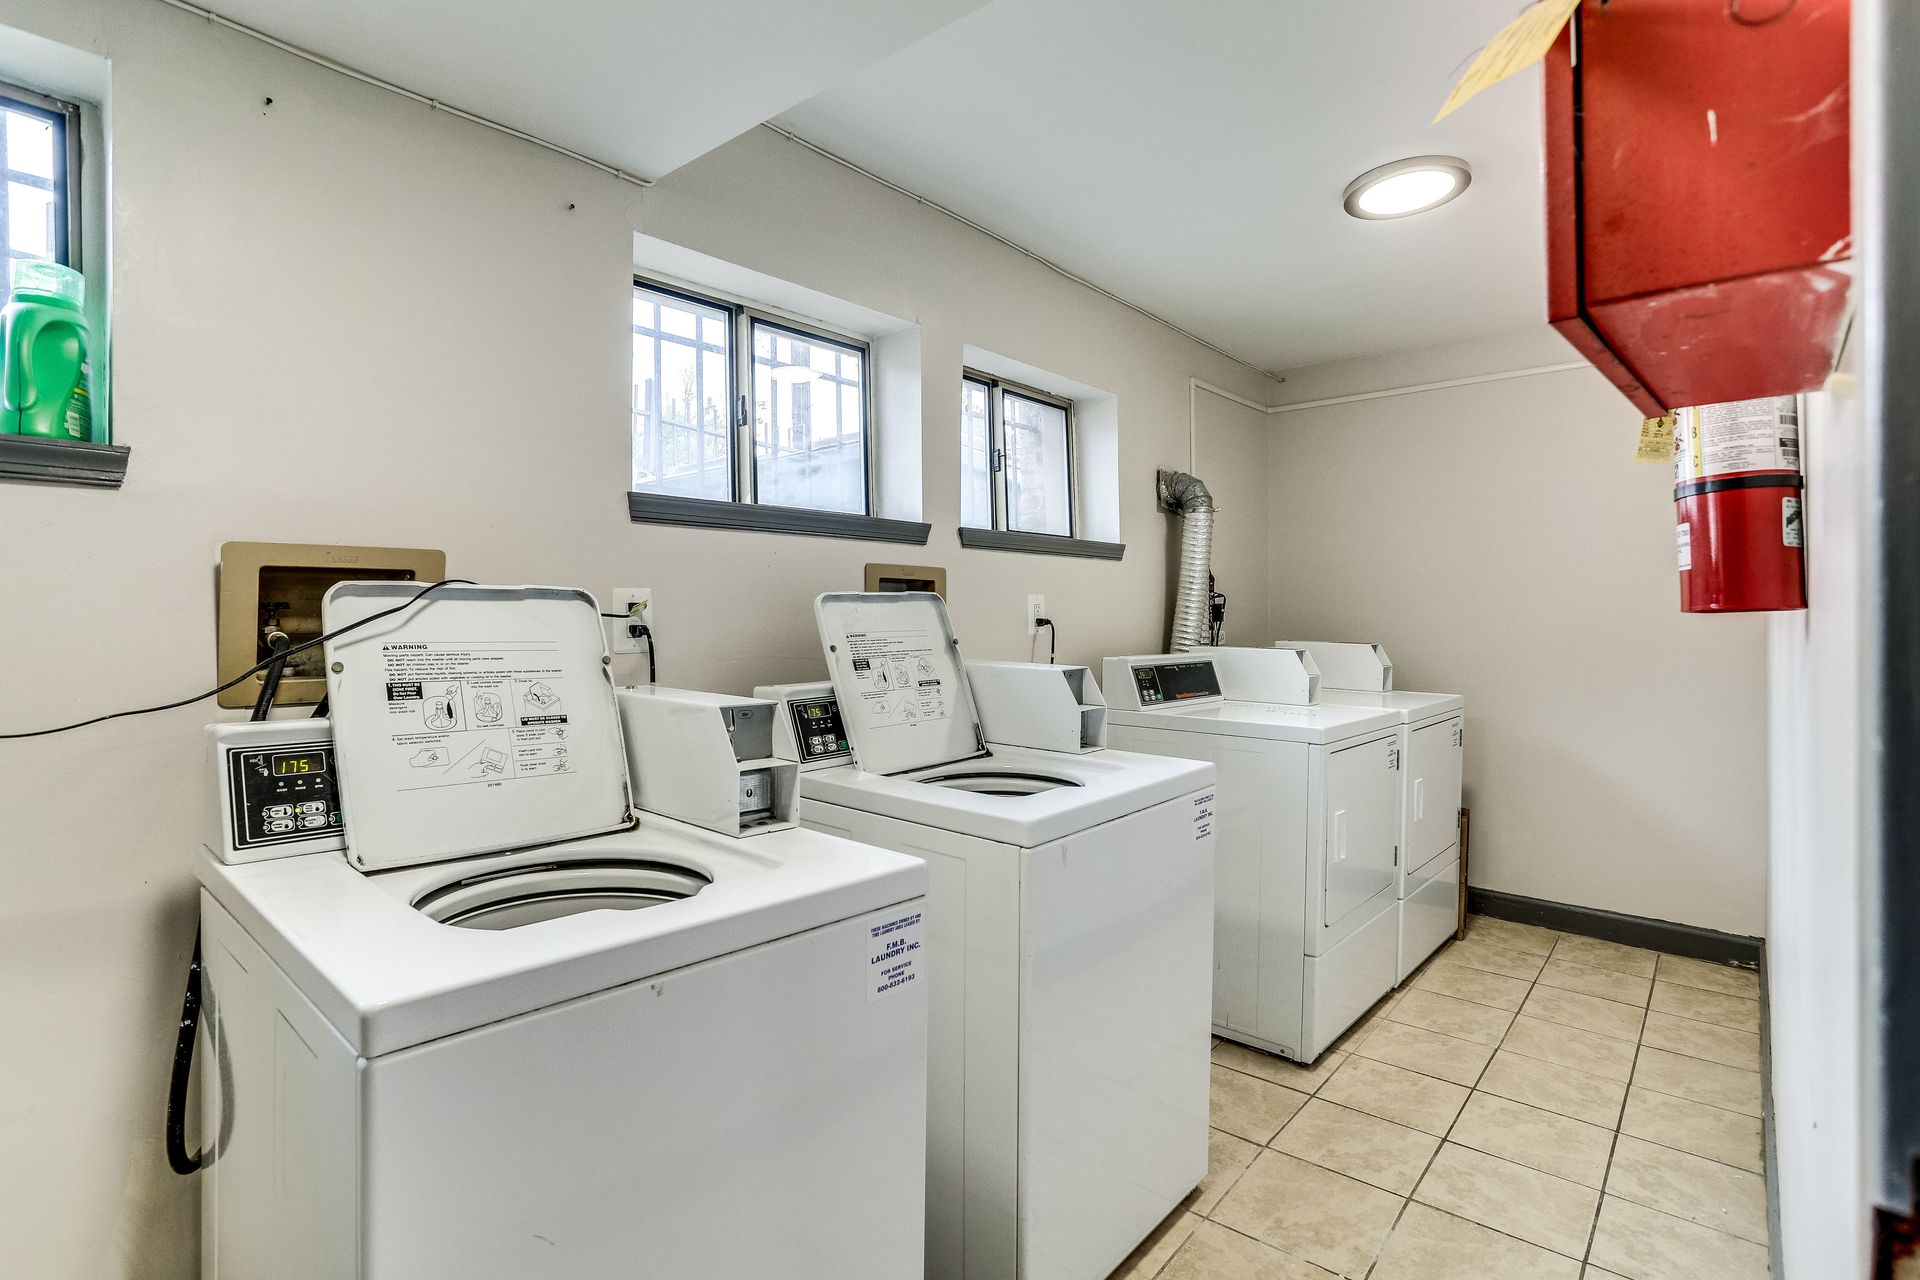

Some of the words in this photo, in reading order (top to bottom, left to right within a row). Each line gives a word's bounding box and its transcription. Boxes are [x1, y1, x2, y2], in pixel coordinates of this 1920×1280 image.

[886, 938, 906, 950] F.M.B.
[871, 947, 905, 964] LAUNDRY
[907, 942, 921, 952] INC.
[881, 968, 891, 976] FOR
[892, 961, 912, 972] SERVICE
[888, 970, 905, 980] PHONE
